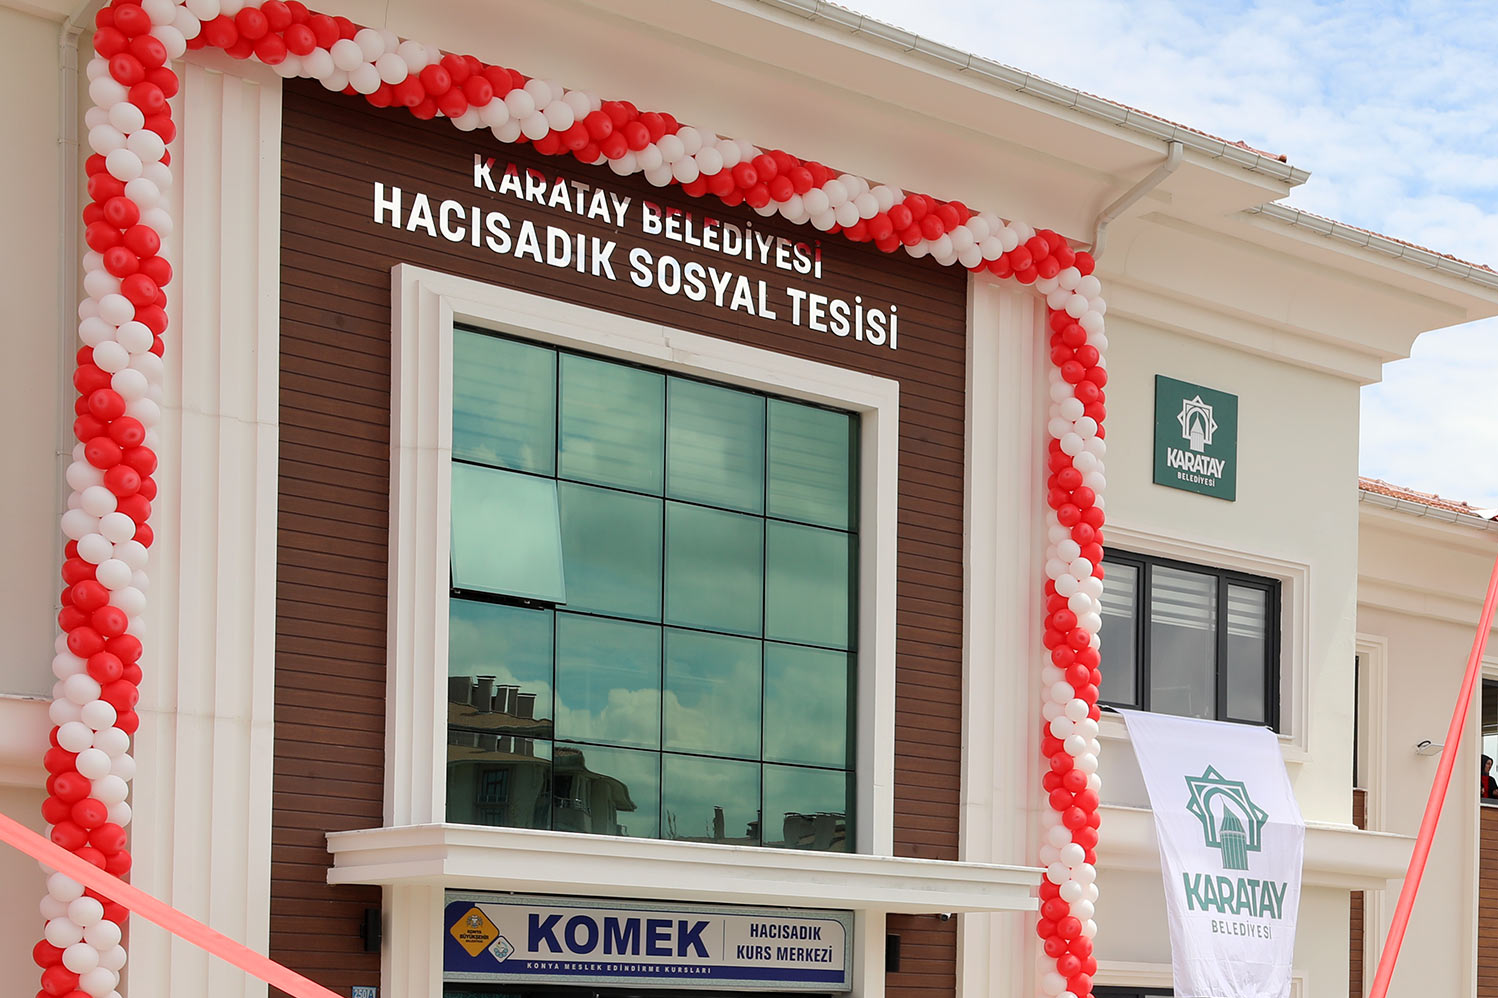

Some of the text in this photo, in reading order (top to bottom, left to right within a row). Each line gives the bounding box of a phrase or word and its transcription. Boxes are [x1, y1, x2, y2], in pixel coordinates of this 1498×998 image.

[473, 153, 823, 279] KARATAY BELEDİYESİ
[372, 181, 899, 350] HACISADIK SOSYAL TESİSİ
[1167, 446, 1225, 479] KARATAY
[1177, 471, 1216, 487] BELEDİYESİ
[1182, 872, 1288, 920] KARATAY
[528, 913, 711, 958] KOMEK
[750, 923, 822, 940] HACISADIK
[1211, 919, 1272, 940] BELEDİYESİ
[736, 945, 833, 962] KURS MERKEZİ
[527, 962, 560, 970] KONYA
[564, 963, 602, 971] MESLEK
[607, 964, 660, 973] EDİNDİRME
